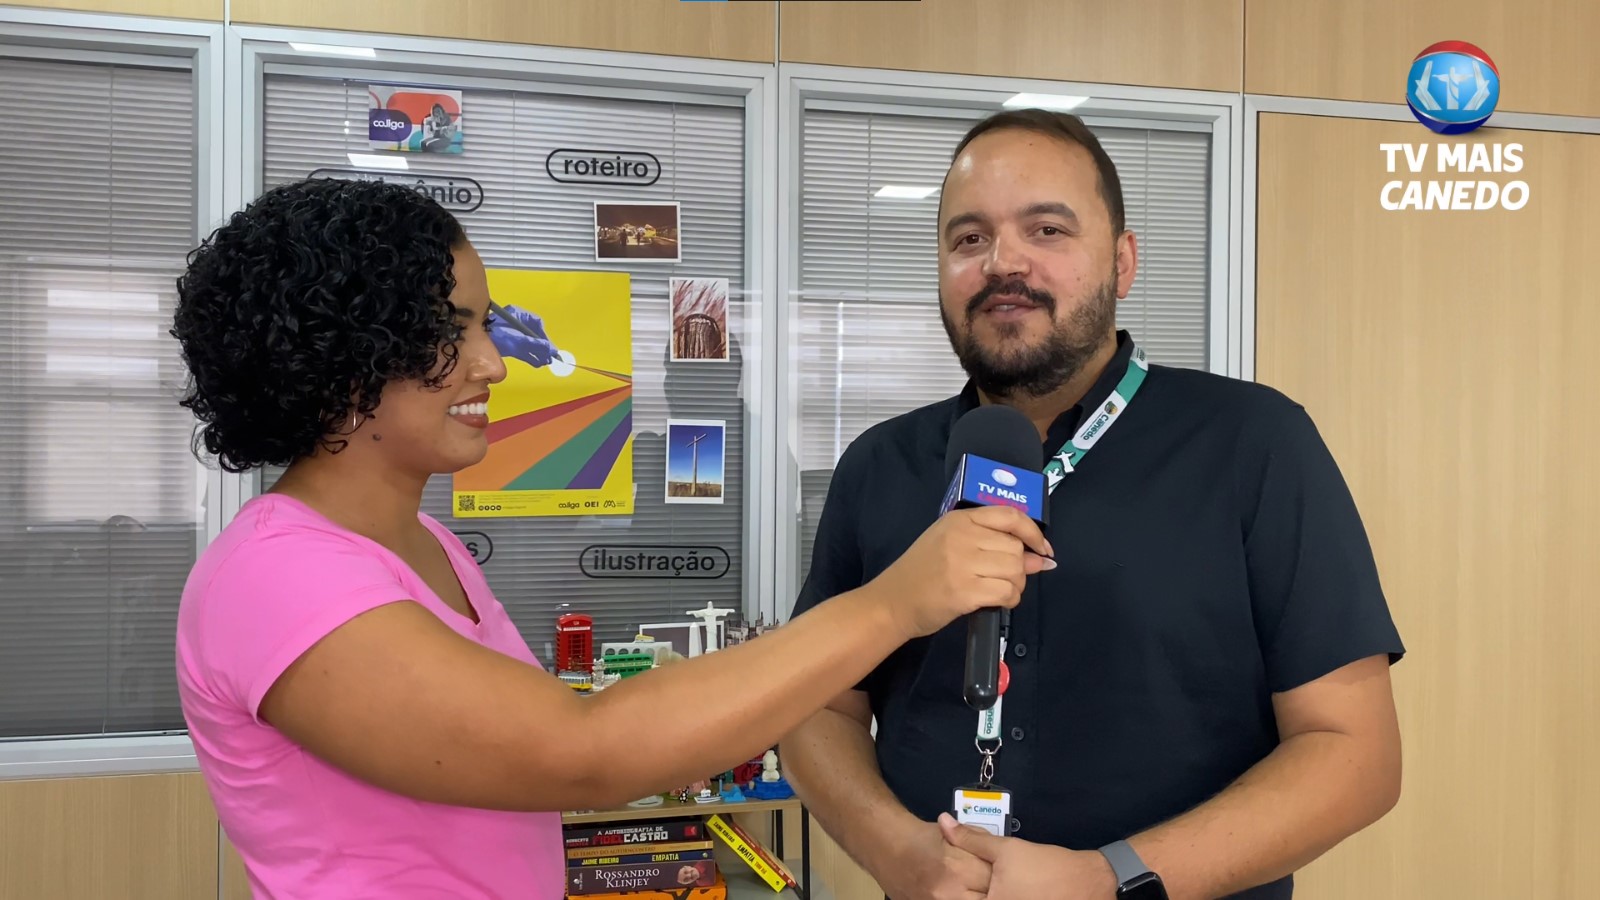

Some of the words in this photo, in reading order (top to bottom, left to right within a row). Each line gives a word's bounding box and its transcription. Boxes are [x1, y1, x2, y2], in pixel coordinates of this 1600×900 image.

[563, 156, 649, 178] roteiro
[1083, 414, 1109, 441] Canedo
[978, 482, 995, 494] TV
[997, 488, 1028, 504] MAIS
[584, 500, 599, 508] OEI
[593, 549, 715, 577] ilustração
[973, 805, 1002, 815] Canedo
[604, 827, 653, 835] AUTOBIOGRAFIA
[623, 831, 668, 843] CASTRO
[581, 858, 598, 866] JAIME
[598, 857, 619, 865] RIBEIRO
[652, 853, 679, 862] EMPATIA
[595, 868, 660, 880] ROSSANDRO
[606, 878, 650, 889] KLINJEY
